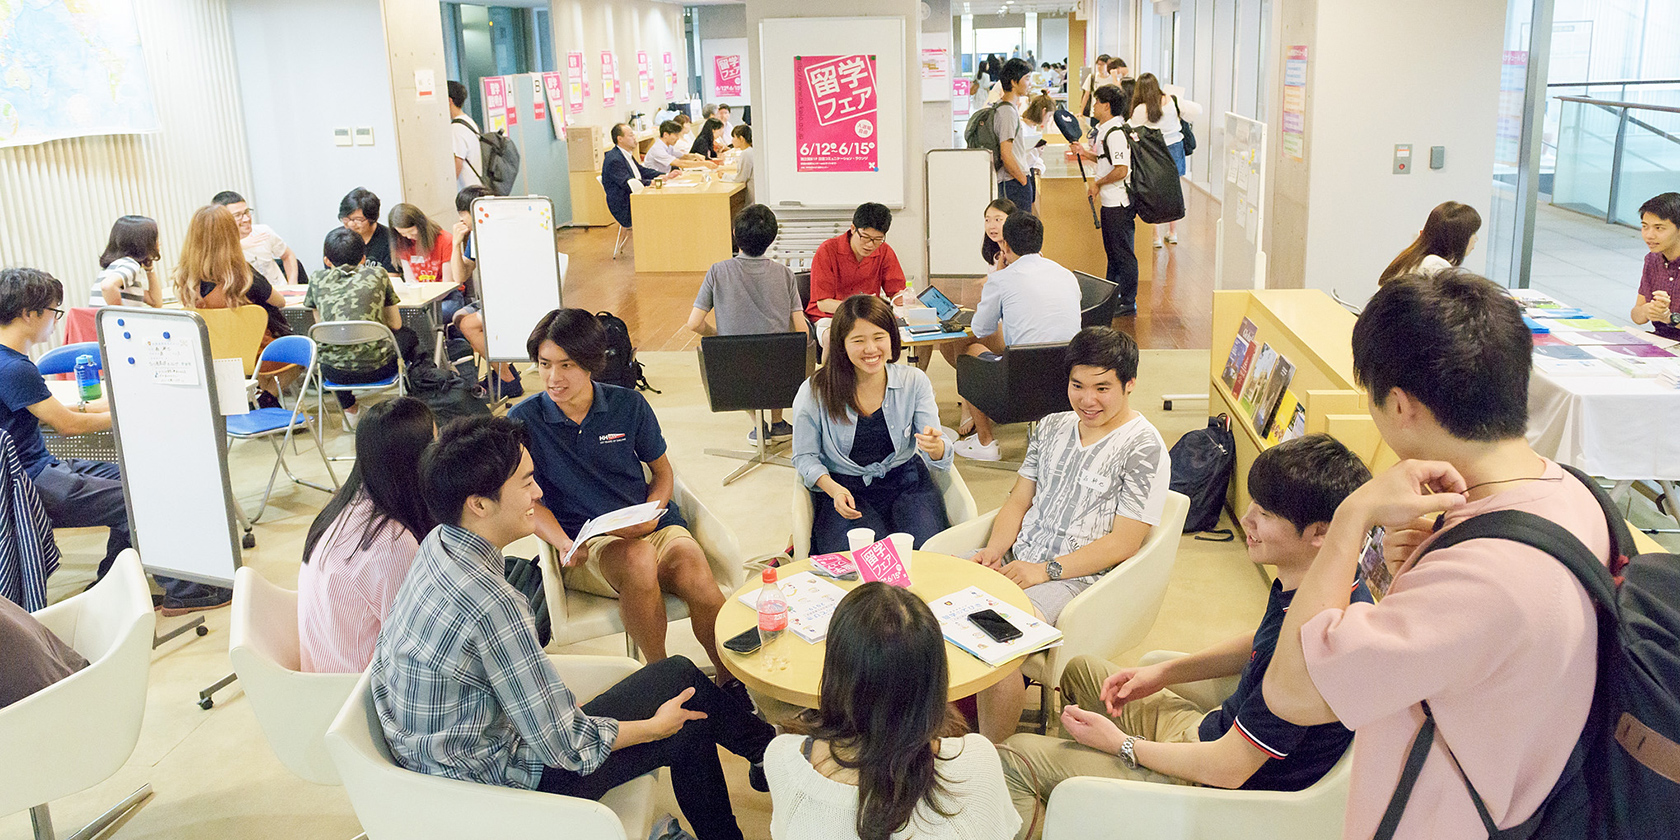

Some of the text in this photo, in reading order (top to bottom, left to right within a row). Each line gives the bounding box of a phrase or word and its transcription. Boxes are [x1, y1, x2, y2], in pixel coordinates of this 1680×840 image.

[534, 79, 541, 93] B
[809, 57, 868, 98] 留学
[818, 86, 872, 119] フェア
[1114, 151, 1124, 160] 24
[864, 541, 884, 567] 留学
[872, 555, 891, 576] フェア
